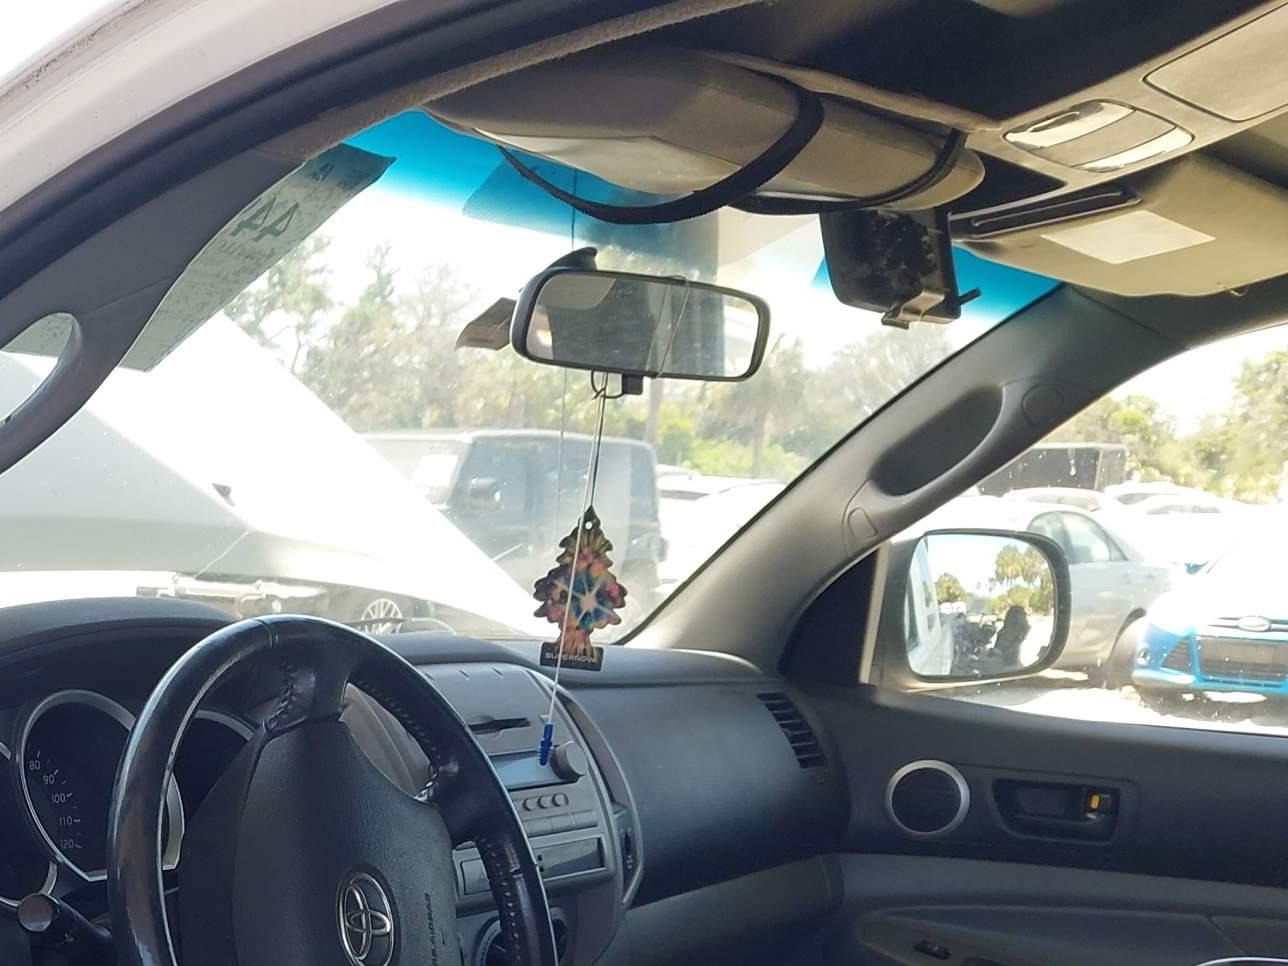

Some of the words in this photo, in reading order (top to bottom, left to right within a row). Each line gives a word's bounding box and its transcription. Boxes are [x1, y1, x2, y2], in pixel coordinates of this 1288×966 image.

[29, 760, 41, 770] 80
[42, 774, 55, 785] 90
[51, 793, 66, 804] 100
[59, 816, 73, 826] 110
